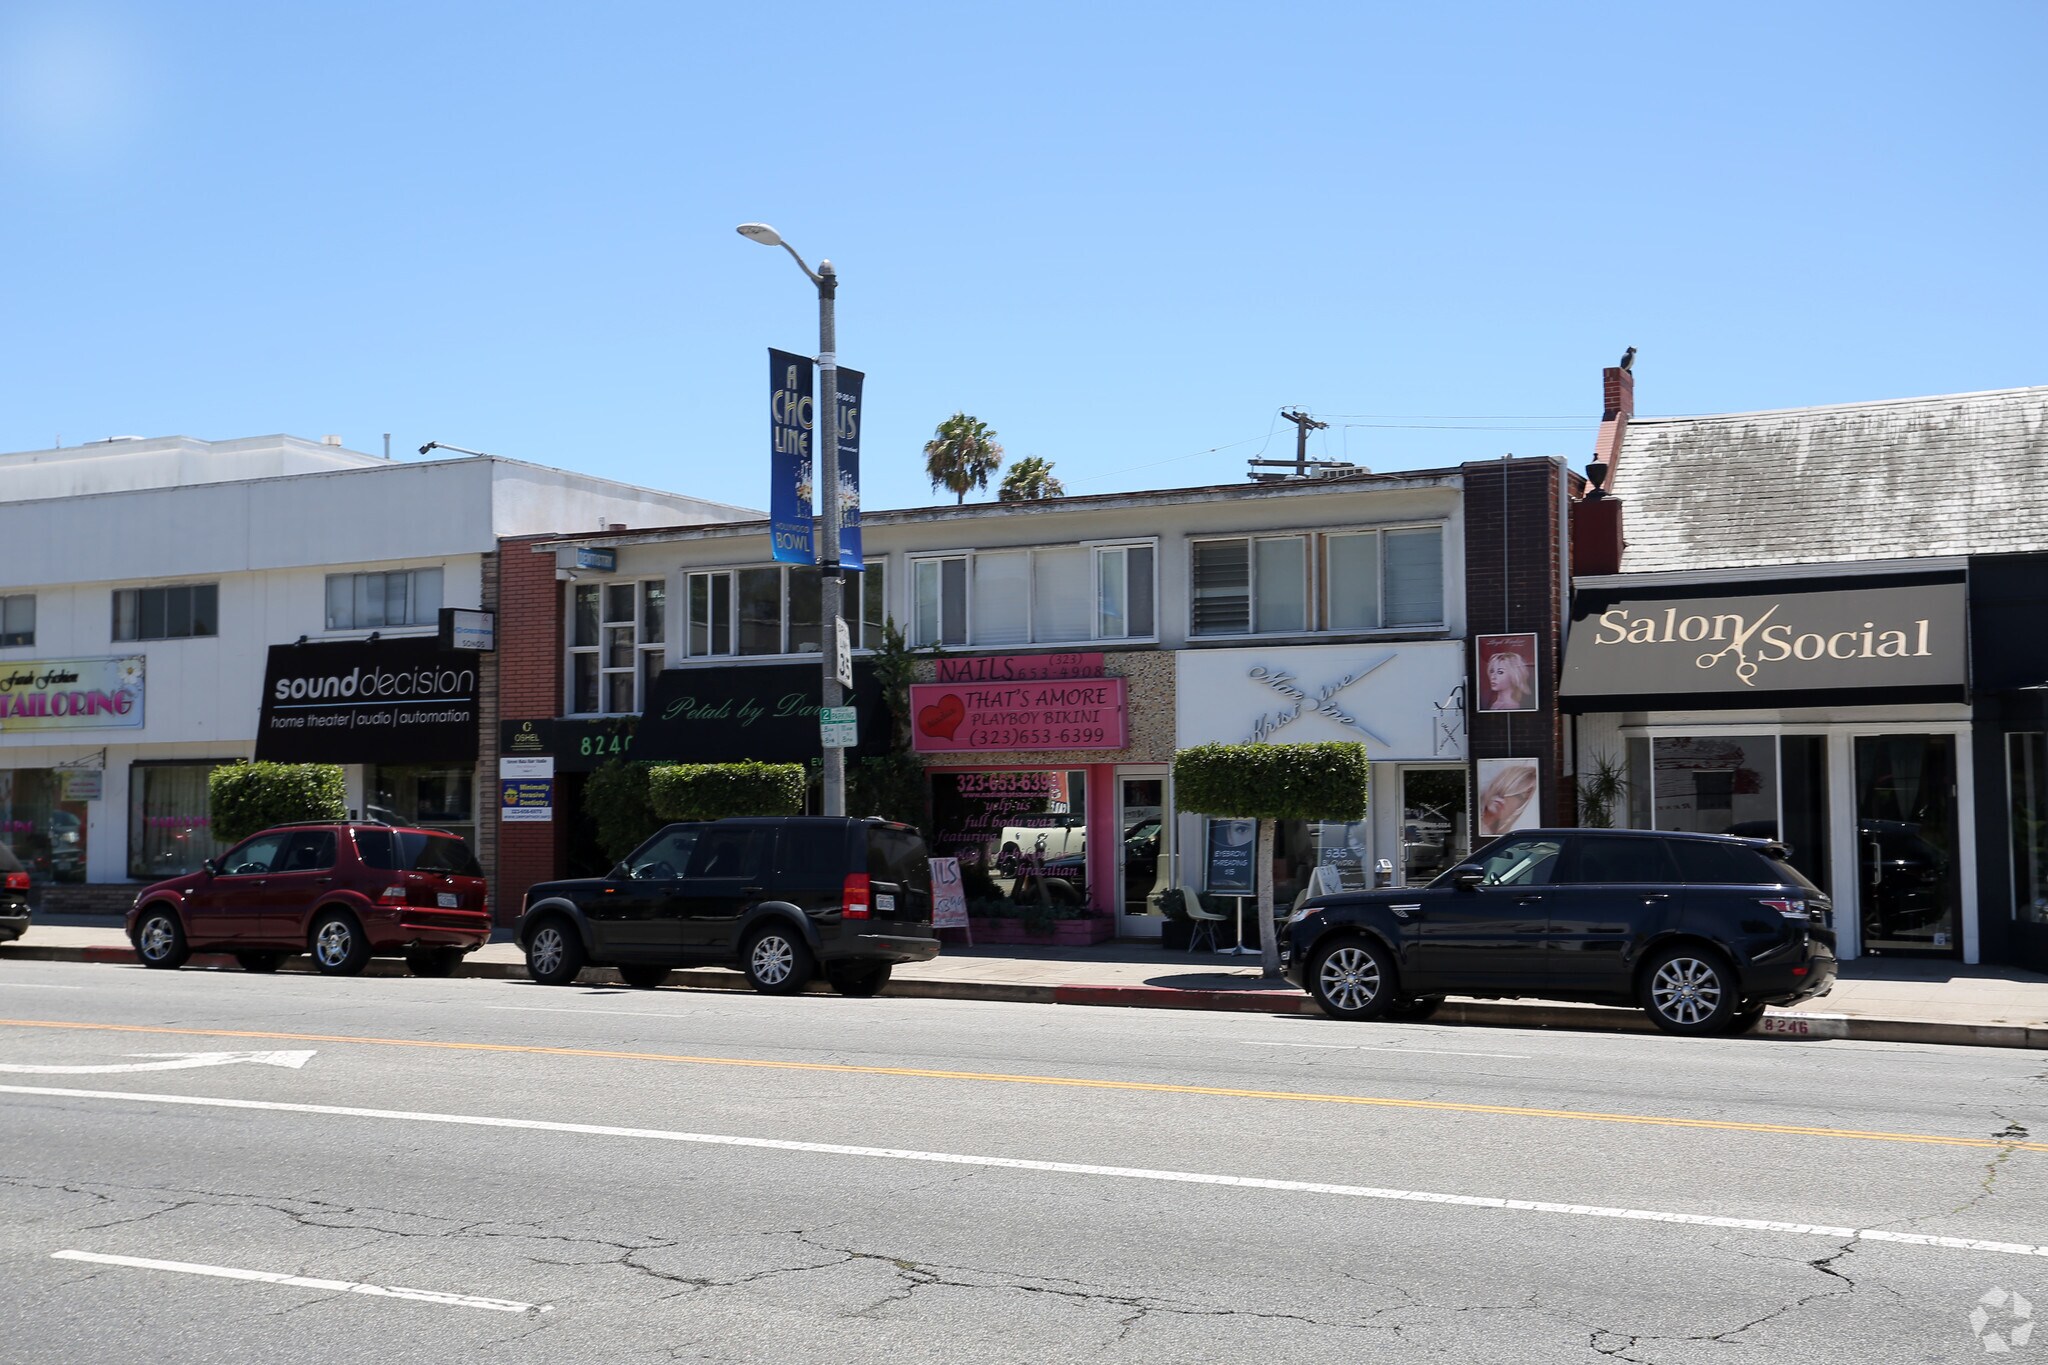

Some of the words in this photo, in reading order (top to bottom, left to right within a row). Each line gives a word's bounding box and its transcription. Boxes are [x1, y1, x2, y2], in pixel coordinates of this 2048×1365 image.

[787, 364, 798, 390] A
[775, 426, 808, 457] LINE
[776, 522, 809, 534] HOLLYWOOD
[775, 532, 811, 552] BOWL
[1594, 607, 1744, 646] Salon
[1757, 619, 1933, 662] Social
[1049, 653, 1083, 665] (323)
[939, 657, 1014, 682] NAILS
[1019, 665, 1103, 679] 653-4908
[0, 688, 133, 718] TAILORING
[965, 688, 1030, 709] THAT'S
[1036, 687, 1108, 707] AMORE
[271, 715, 305, 728] home
[400, 708, 470, 724] automation
[662, 696, 733, 721] Petals
[737, 697, 765, 727] by
[972, 712, 1040, 726] PLAYBOY
[1043, 709, 1100, 724] BIKINI
[969, 727, 1105, 746] (323)653-6399
[964, 814, 988, 831] full
[1212, 858, 1248, 867] THREADING
[1214, 850, 1247, 858] EYEBROW
[1017, 862, 1078, 876] brazilian
[1764, 1019, 1809, 1035] 8246
